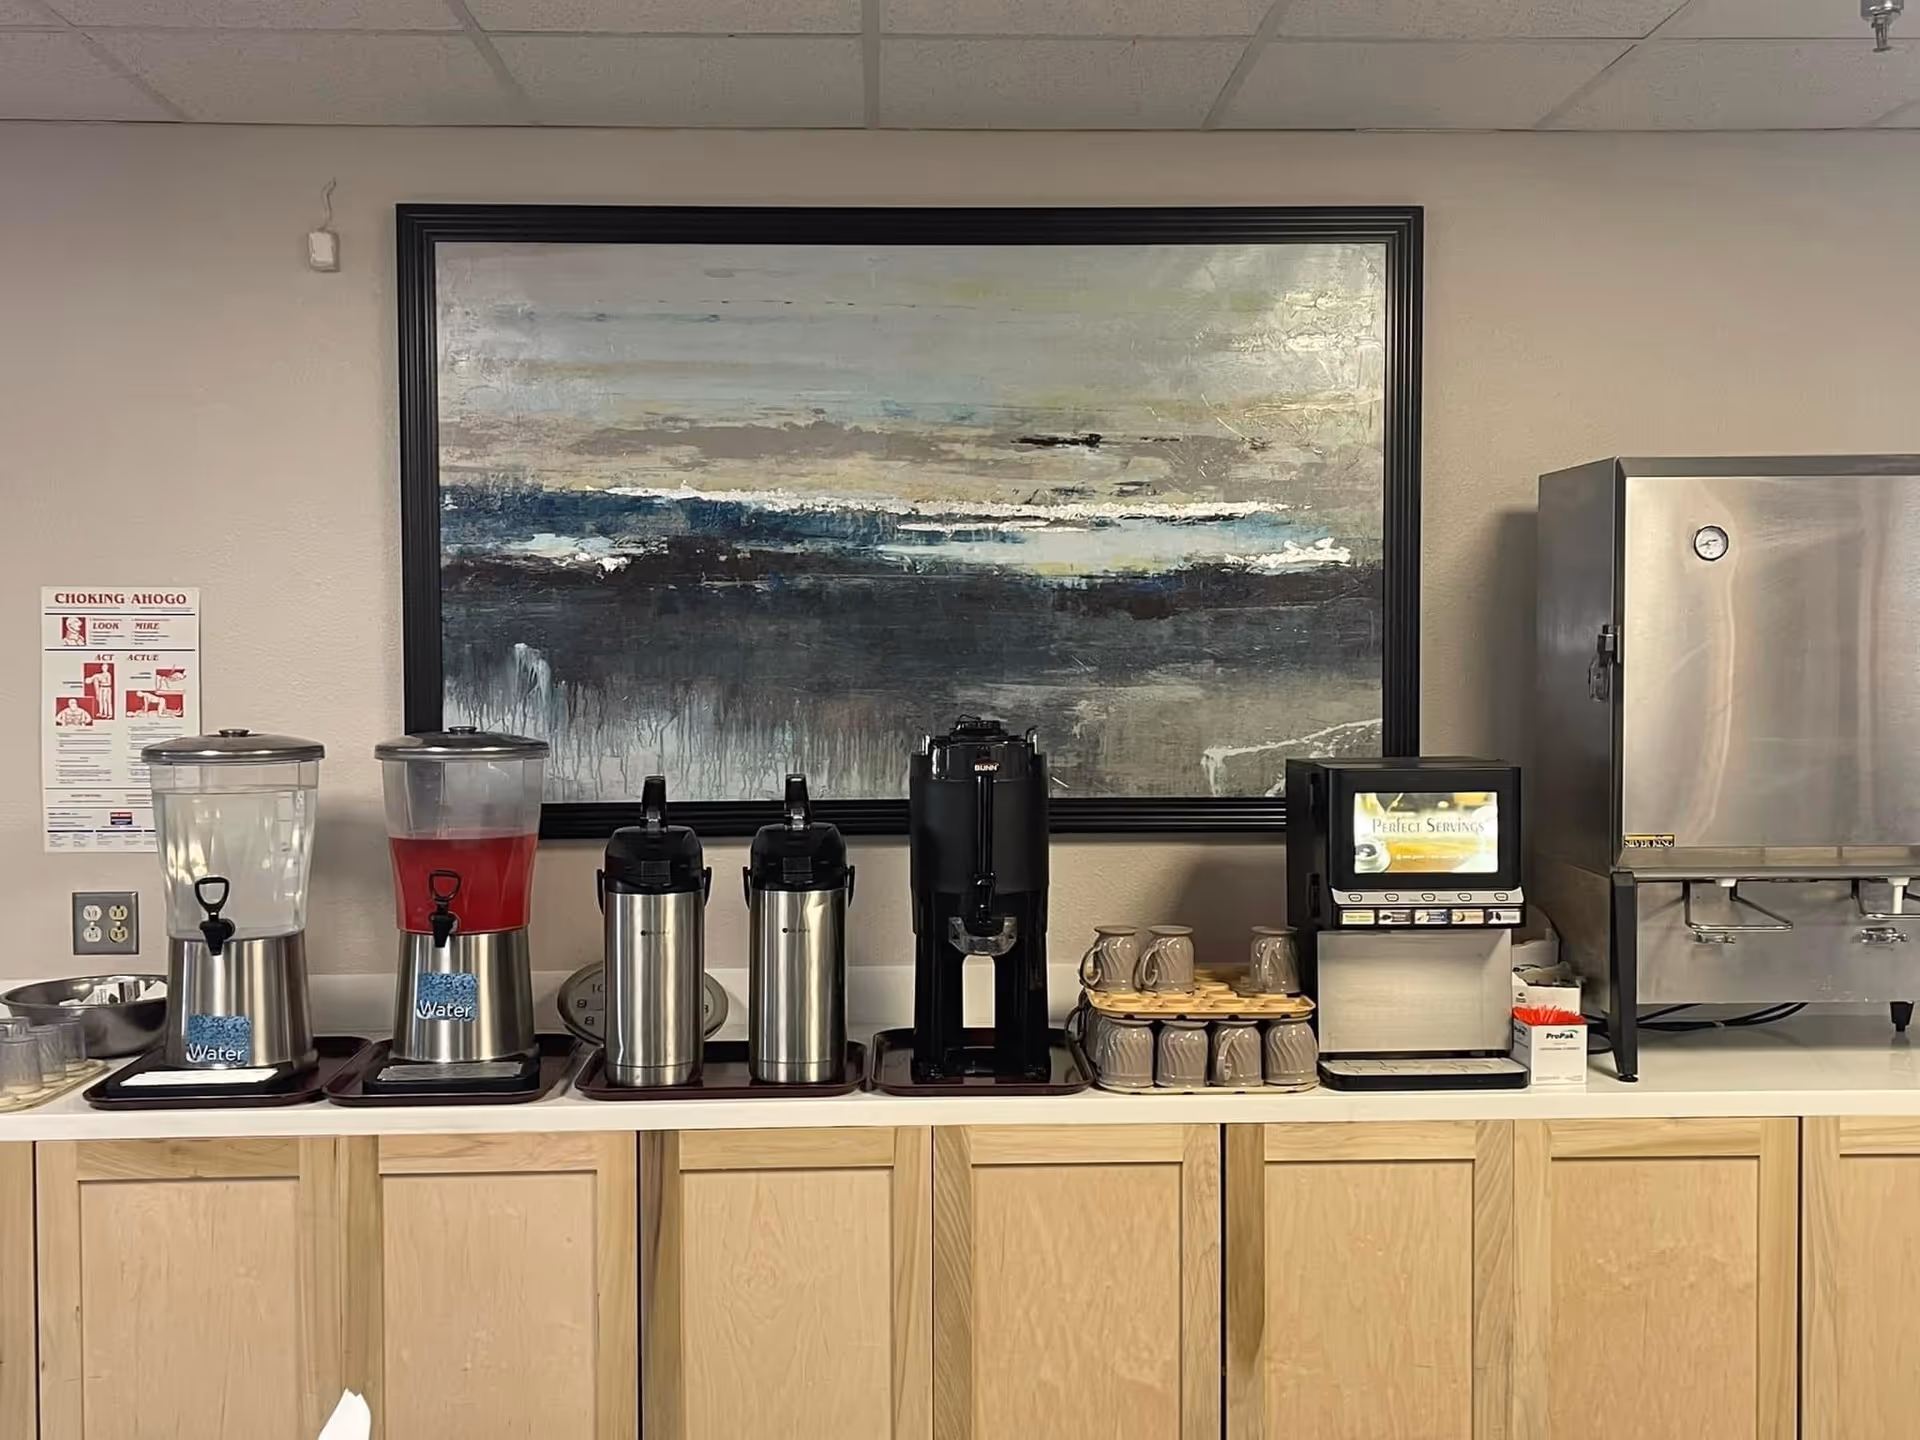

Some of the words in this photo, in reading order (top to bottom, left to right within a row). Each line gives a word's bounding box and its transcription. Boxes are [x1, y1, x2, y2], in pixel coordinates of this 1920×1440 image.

[55, 593, 125, 604] CHOKING
[131, 593, 187, 604] AHOGO
[92, 622, 119, 630] LOOK
[135, 622, 160, 630] MIRE
[974, 763, 998, 771] BUNN
[420, 999, 472, 1018] Water
[1545, 1032, 1574, 1040] ProPak
[189, 1043, 245, 1061] Water
